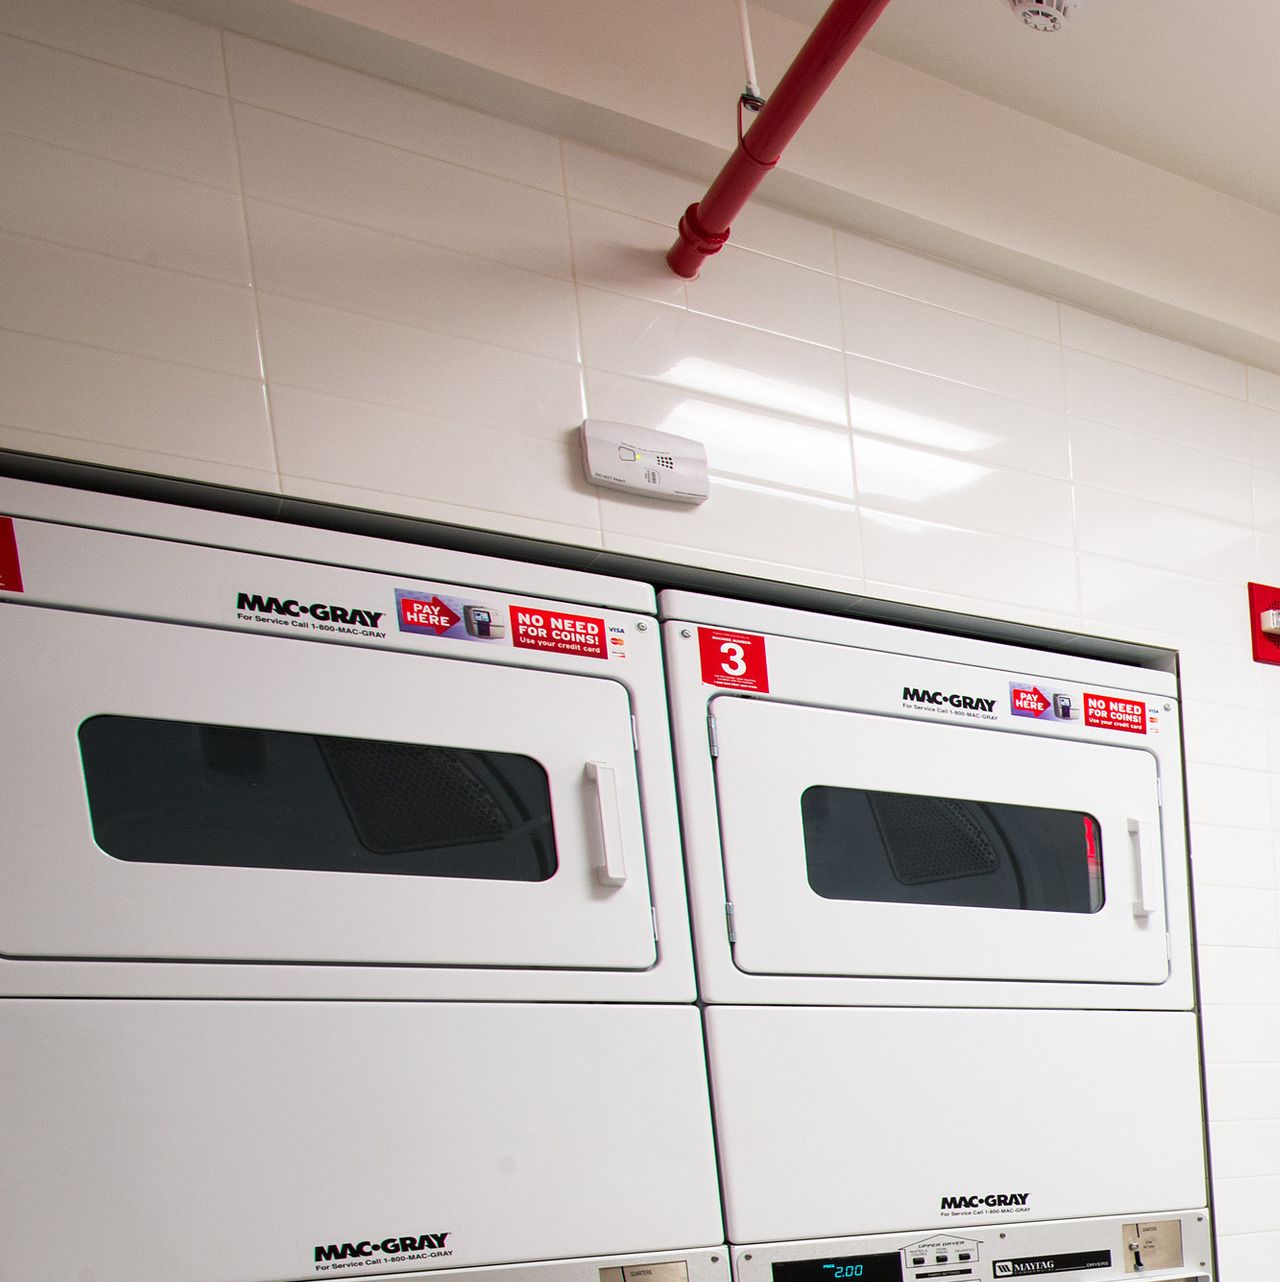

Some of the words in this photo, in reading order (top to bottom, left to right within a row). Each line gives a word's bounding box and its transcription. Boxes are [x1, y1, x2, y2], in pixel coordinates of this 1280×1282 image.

[413, 603, 441, 615] PAY
[237, 613, 252, 621] For
[255, 615, 289, 626] Service
[292, 620, 309, 628] Call
[311, 623, 386, 639] 1-800-MAC-GRAY
[407, 612, 450, 626] HERE
[518, 612, 544, 627] NO
[550, 617, 599, 635] NEED
[519, 625, 548, 638] FOR
[552, 630, 600, 645] COINS!
[520, 636, 536, 645] Use
[538, 640, 556, 649] your
[558, 641, 581, 651] credit
[583, 645, 600, 654] card
[720, 642, 747, 676] 3
[1020, 692, 1038, 702] PAY
[914, 704, 936, 712] Service
[950, 709, 998, 720] 1-800-MAC-GRAY
[1015, 700, 1044, 711] HERE
[1088, 698, 1105, 709] NO
[1109, 701, 1142, 715] NEED
[1088, 708, 1107, 718] FOR
[1110, 711, 1142, 723] COINS!
[1113, 721, 1130, 729] credit
[332, 1261, 363, 1270] Service
[365, 1258, 381, 1266] Call
[384, 1250, 453, 1263] 1-800-MAC-GRAY
[1014, 1260, 1054, 1271] MAYTAG
[834, 1265, 863, 1278] 2.00
